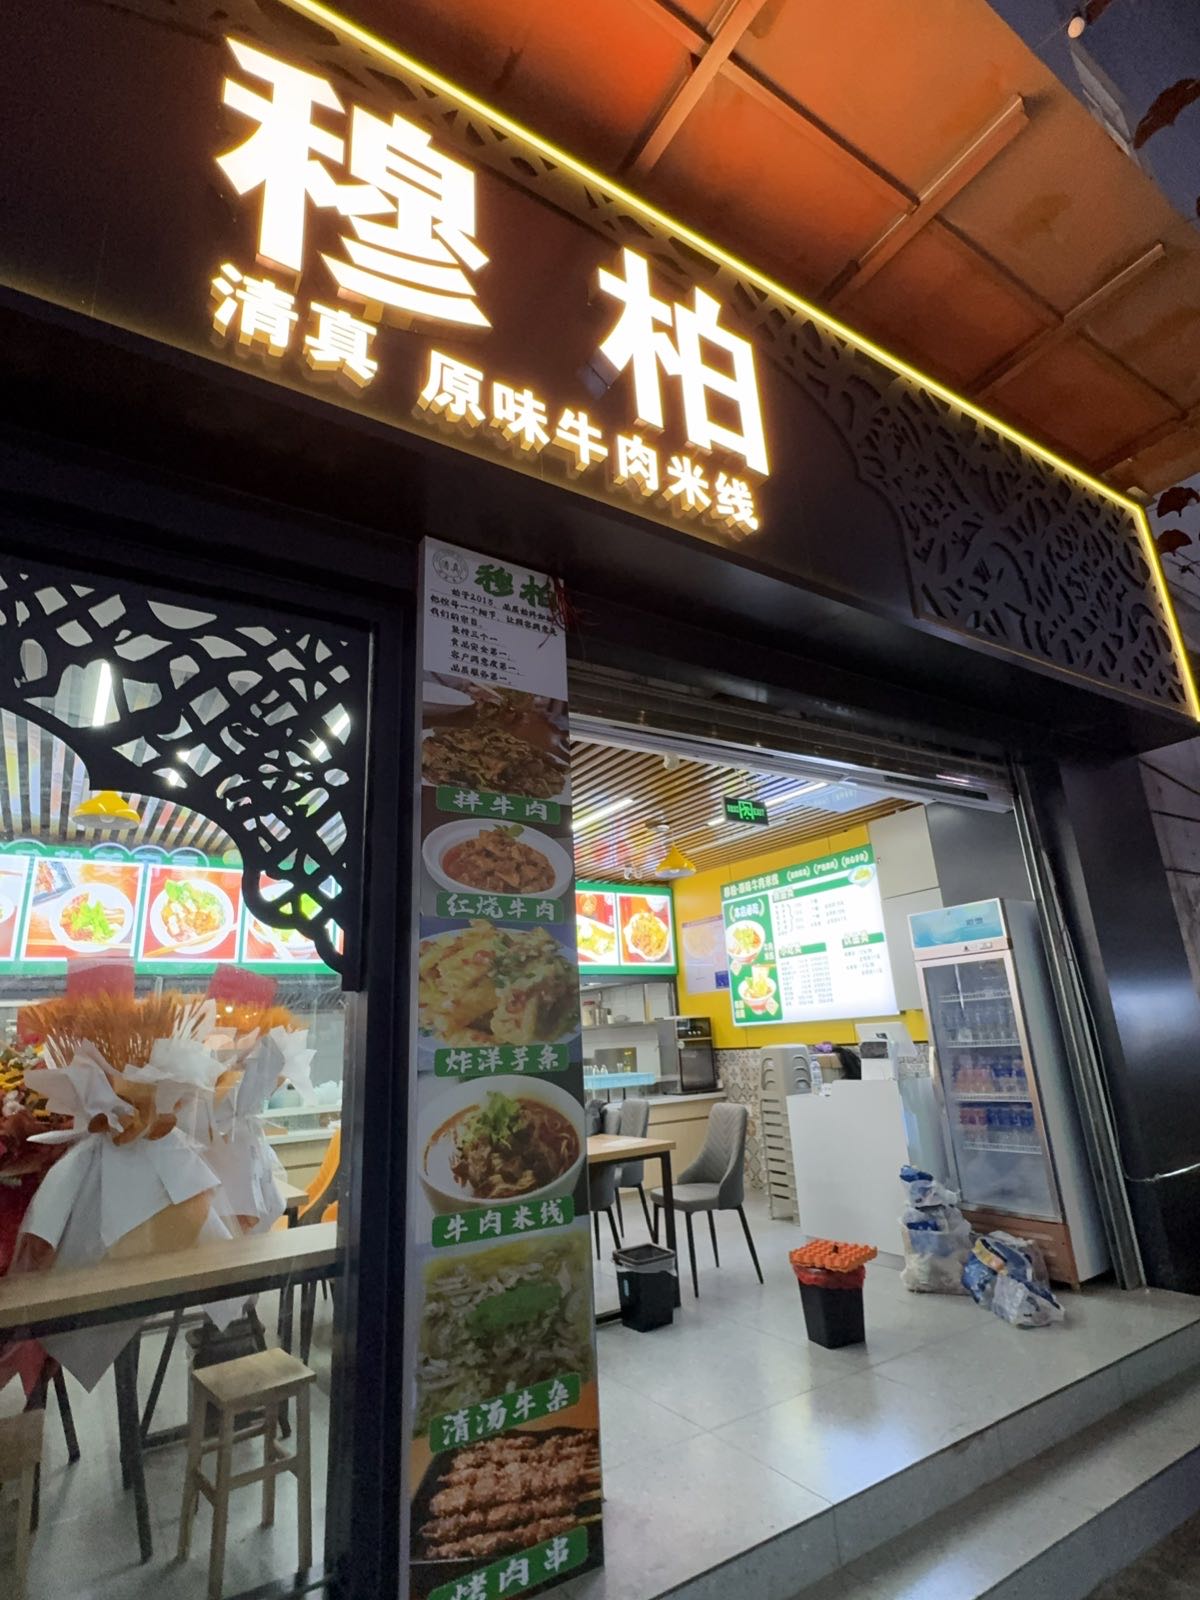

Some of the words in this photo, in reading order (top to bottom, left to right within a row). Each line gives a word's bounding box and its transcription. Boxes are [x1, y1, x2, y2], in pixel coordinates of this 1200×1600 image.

[214, 35, 770, 477] 穆柏
[210, 262, 379, 384] 清真
[417, 350, 760, 532] 原味牛肉米线
[453, 790, 548, 821] 拌牛肉
[446, 893, 555, 921] 红烧牛肉
[445, 1044, 559, 1074] 炸洋芋条
[443, 1199, 565, 1243] 牛肉米线
[441, 1380, 570, 1446] 清汤牛杂
[449, 1537, 569, 1600] 烤肉串
